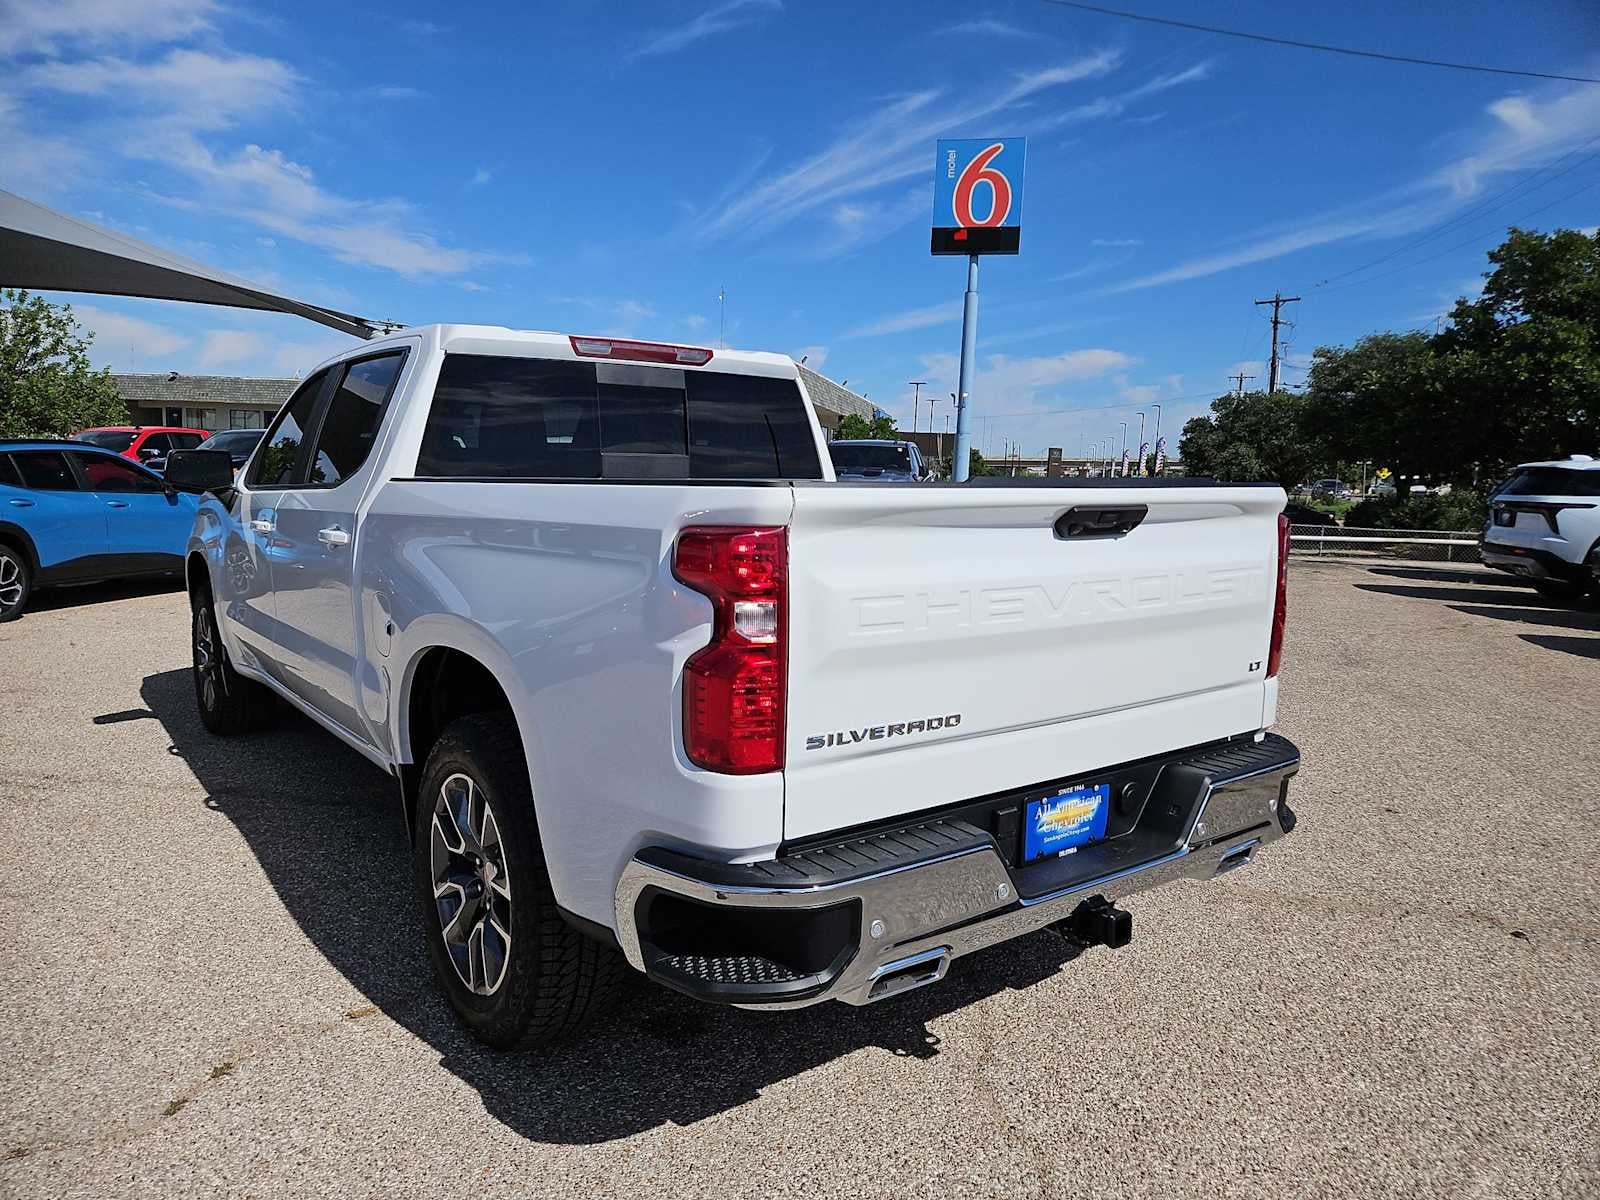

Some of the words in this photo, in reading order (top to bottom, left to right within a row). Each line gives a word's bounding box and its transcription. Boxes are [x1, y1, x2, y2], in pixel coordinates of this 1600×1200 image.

[947, 150, 957, 178] motel
[952, 142, 1012, 228] 6
[848, 565, 1264, 637] CHEVROLET
[1248, 660, 1262, 673] LT
[806, 714, 961, 751] SILVERADO
[1058, 786, 1074, 795] SINCE
[1035, 803, 1052, 820] All
[1055, 795, 1102, 814] American
[1044, 812, 1093, 832] Chevrolet
